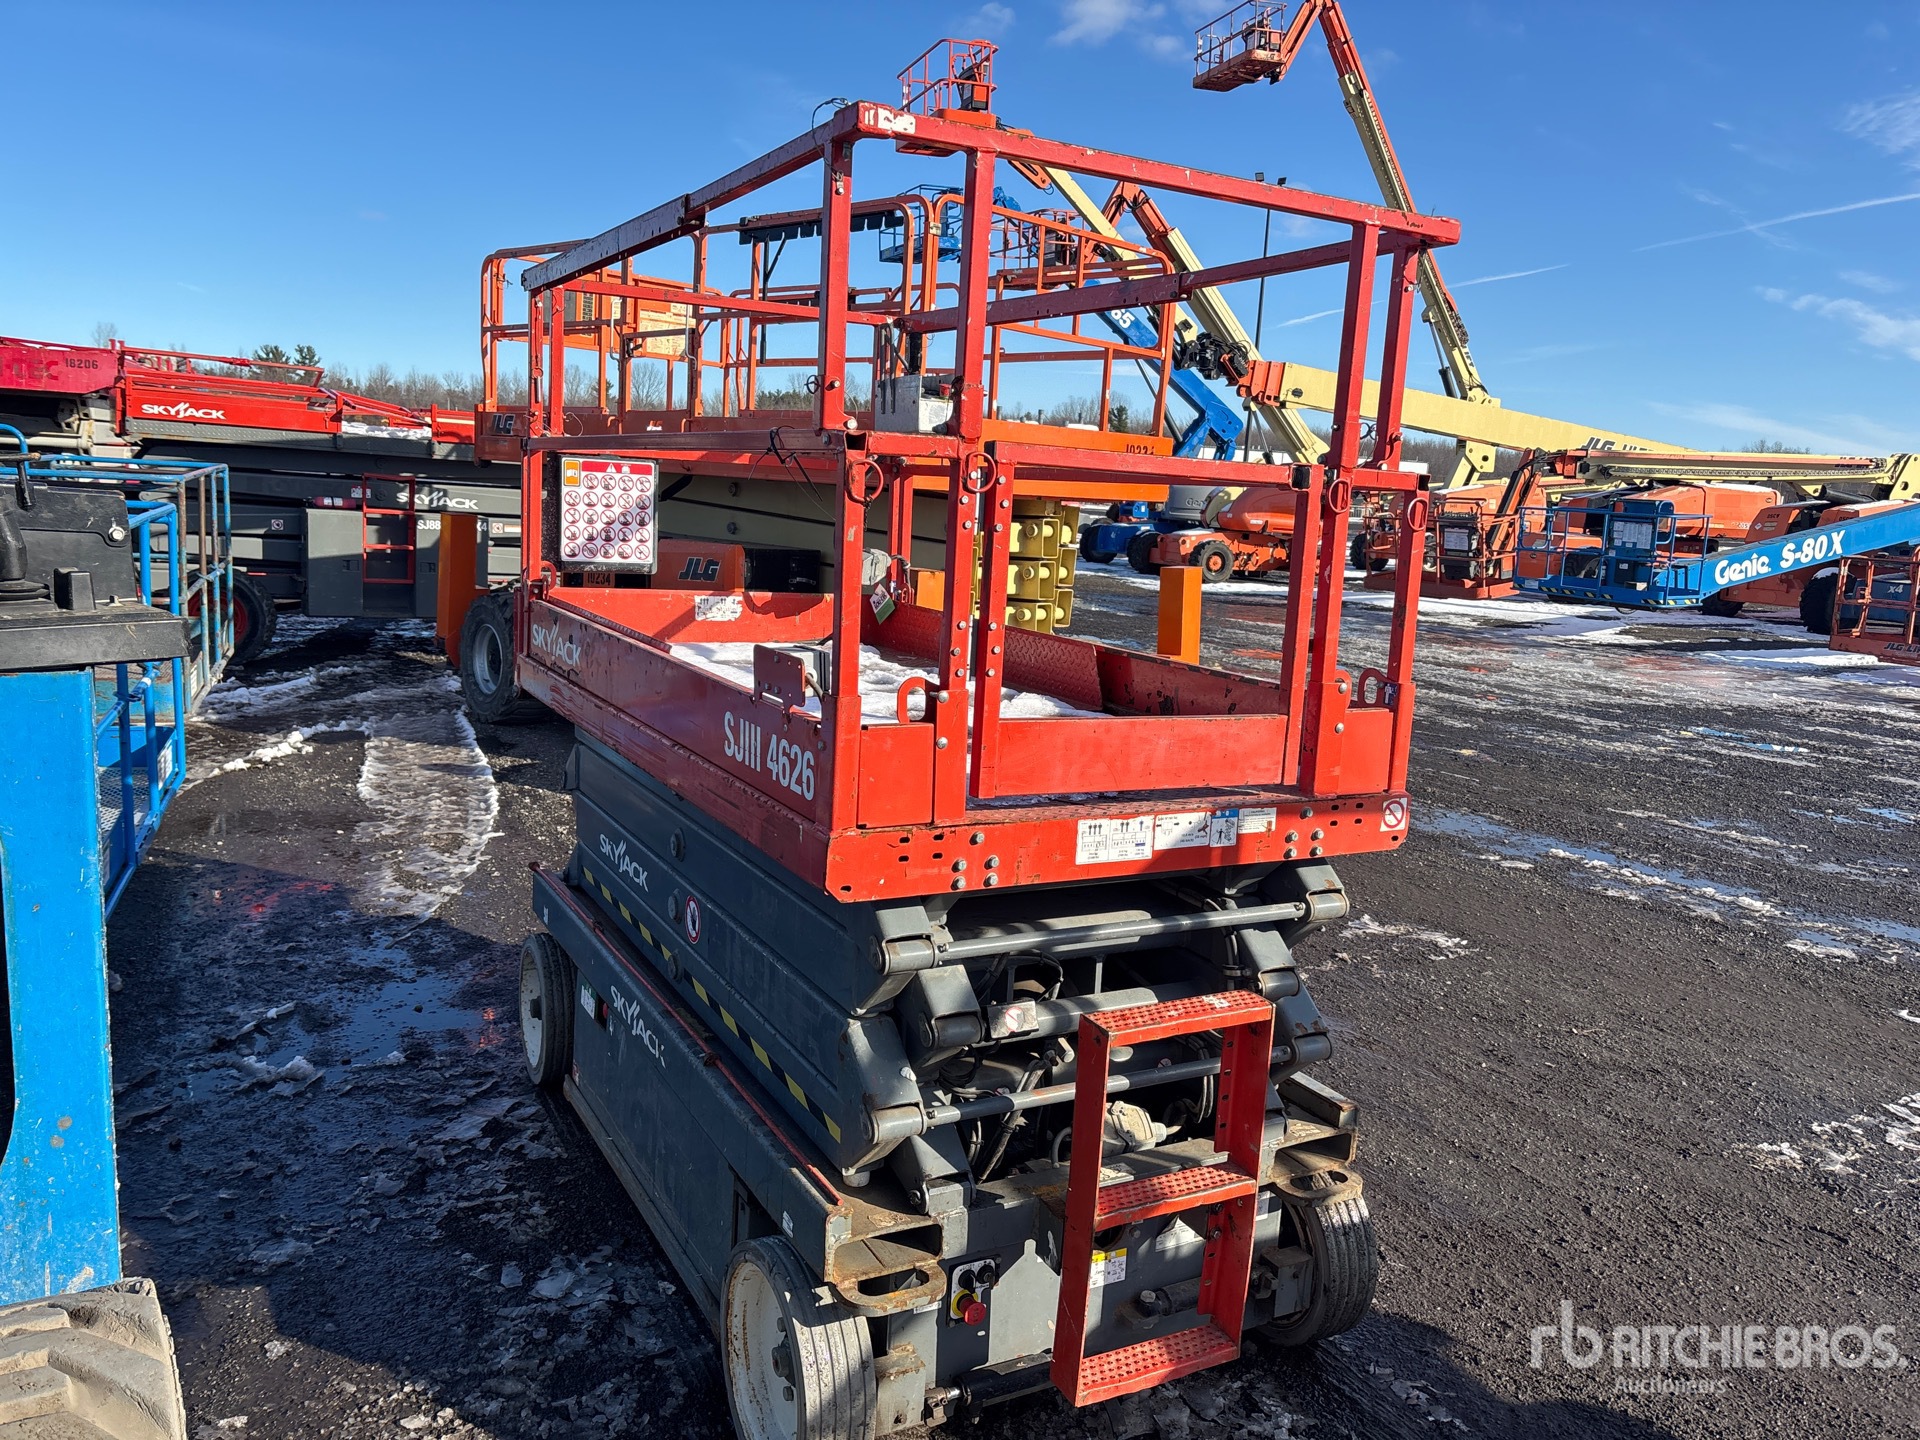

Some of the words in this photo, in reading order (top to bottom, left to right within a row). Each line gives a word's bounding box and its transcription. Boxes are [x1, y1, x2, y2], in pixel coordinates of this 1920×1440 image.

[141, 402, 226, 420] SKYJACK
[396, 491, 479, 509] SKYJACK
[417, 519, 441, 530] SJ88
[679, 557, 721, 582] JLG
[1714, 552, 1771, 585] Genie
[532, 620, 581, 667] SKYJACK
[1884, 642, 1905, 652] JLG
[766, 733, 815, 801] 4626
[600, 833, 649, 893] SKYJACK
[611, 985, 666, 1069] SKYJACK
